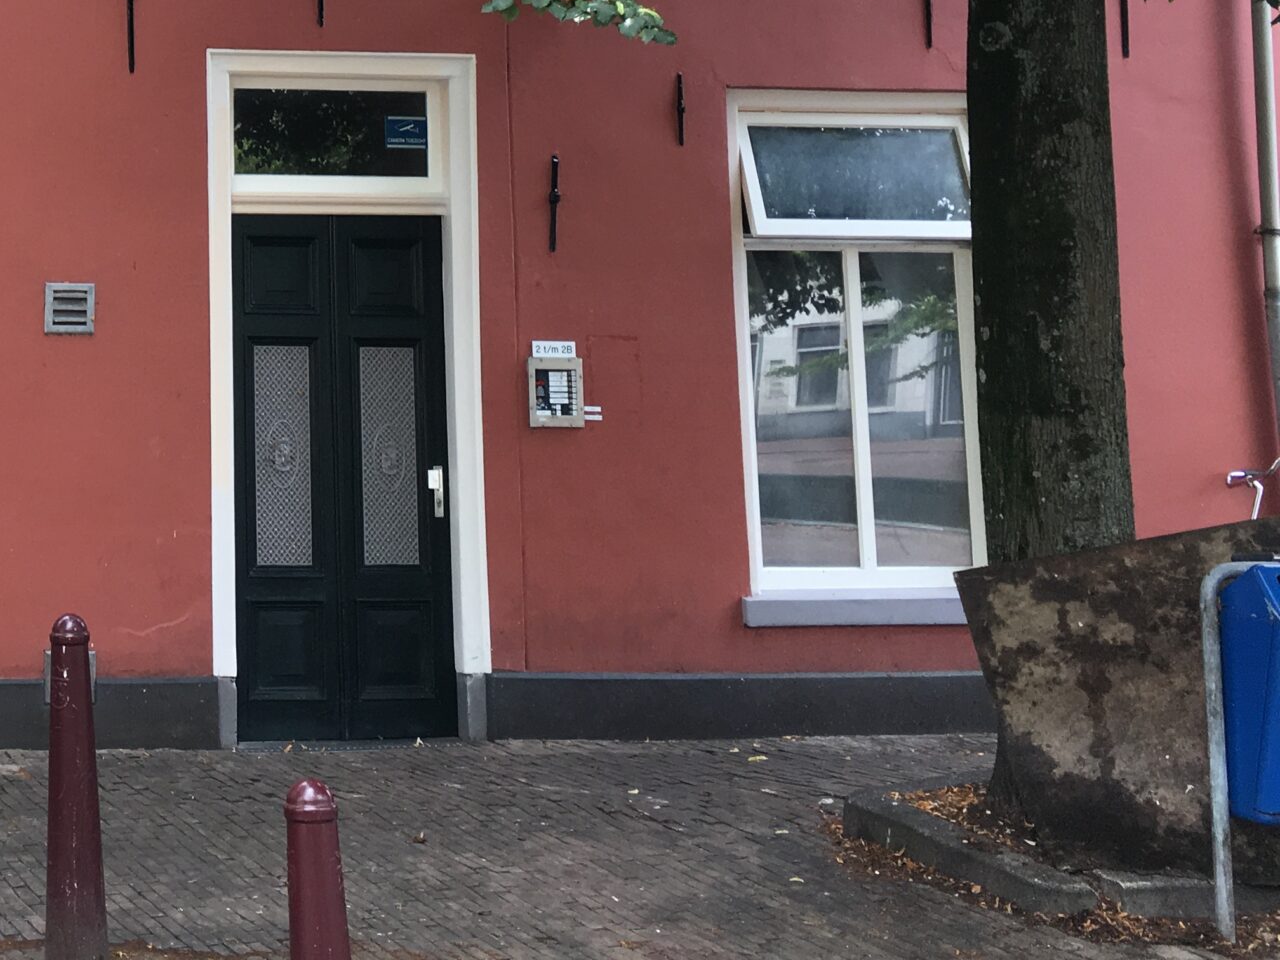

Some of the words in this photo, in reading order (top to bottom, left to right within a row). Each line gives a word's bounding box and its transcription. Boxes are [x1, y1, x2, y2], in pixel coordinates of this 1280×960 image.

[535, 345, 541, 354] 2
[543, 345, 559, 354] t/m
[561, 345, 573, 354] 2B
